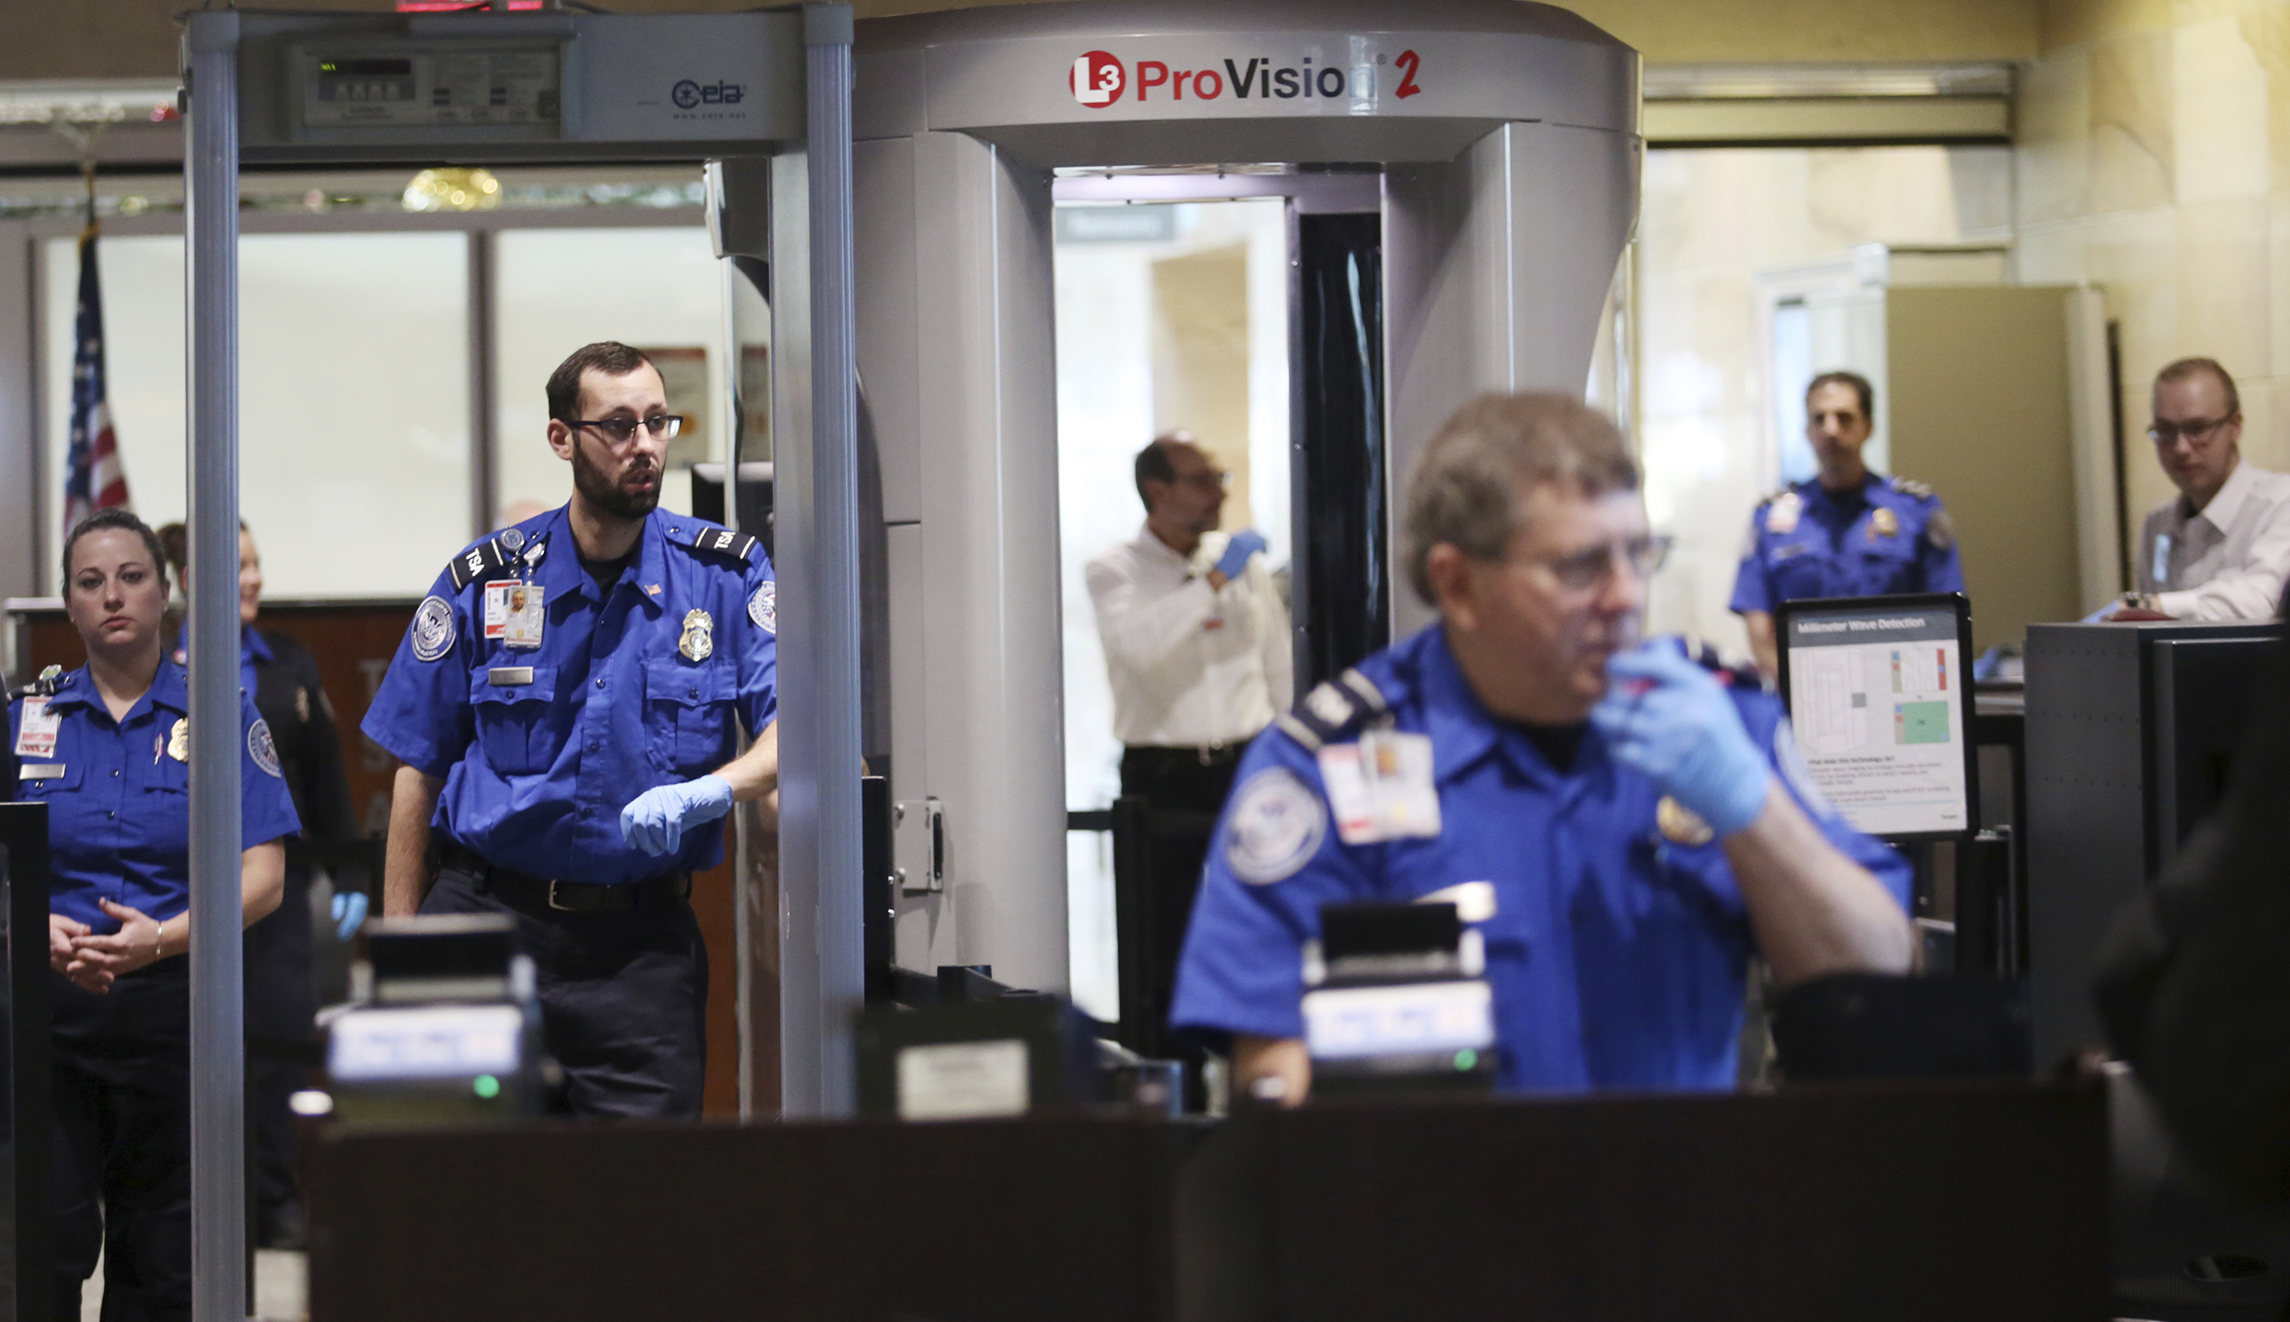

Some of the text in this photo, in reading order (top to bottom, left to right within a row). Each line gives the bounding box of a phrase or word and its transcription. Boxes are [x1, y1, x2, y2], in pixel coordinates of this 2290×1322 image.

[1073, 49, 1421, 104] L3 ProVision 2
[714, 531, 736, 549] TSA
[465, 547, 485, 577] TSA
[1798, 617, 1926, 634] Millimeter Wave Detection
